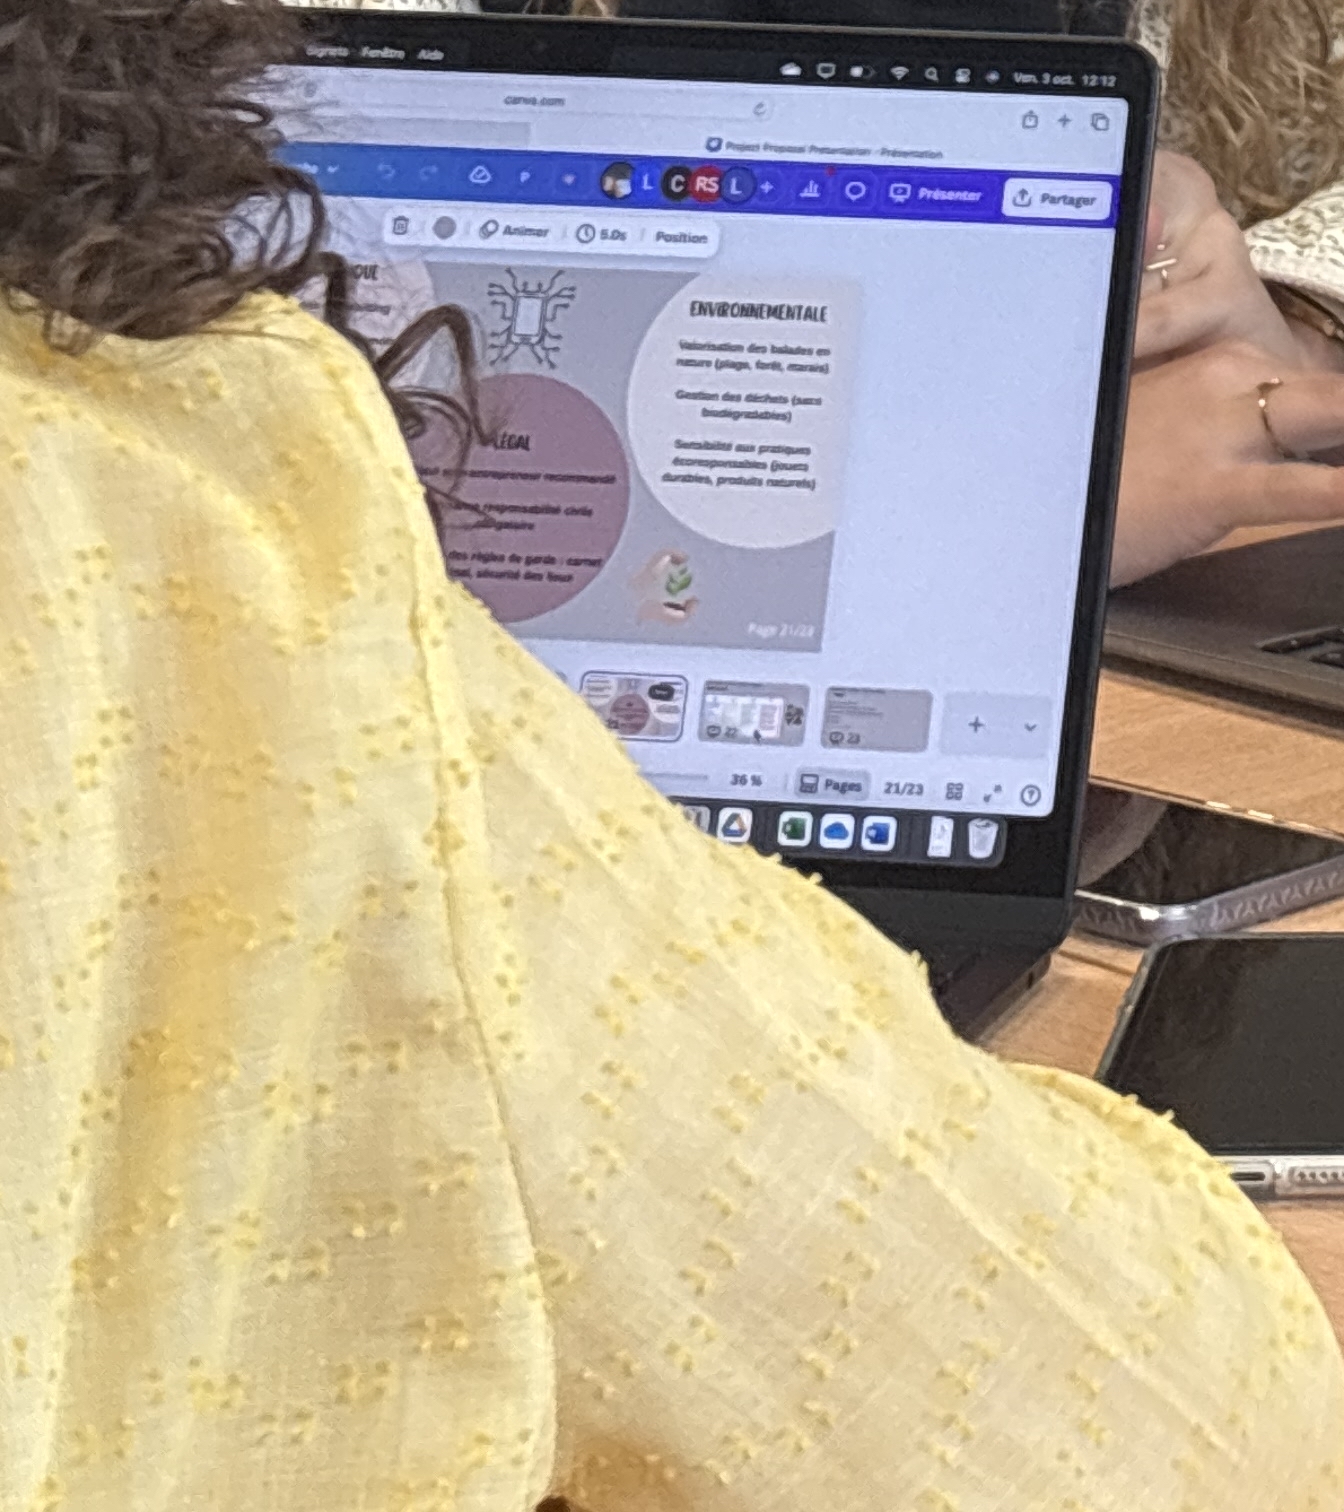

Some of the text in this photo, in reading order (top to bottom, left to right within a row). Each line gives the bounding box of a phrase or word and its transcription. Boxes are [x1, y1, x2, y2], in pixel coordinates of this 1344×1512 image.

[726, 140, 760, 153] Project
[670, 174, 685, 193] C
[695, 176, 719, 194] RS
[730, 177, 742, 194] L
[917, 187, 983, 202] Présenter
[1040, 193, 1096, 209] Partager
[502, 224, 549, 238] Animer
[655, 230, 709, 245] Position
[690, 300, 828, 323] ENVIRONNEMENTALE
[747, 342, 767, 354] des
[722, 391, 741, 402] des
[716, 476, 763, 488] produits
[509, 553, 522, 564] de
[731, 773, 748, 786] 36
[824, 778, 863, 793] Pages
[883, 781, 924, 797] 21/23
